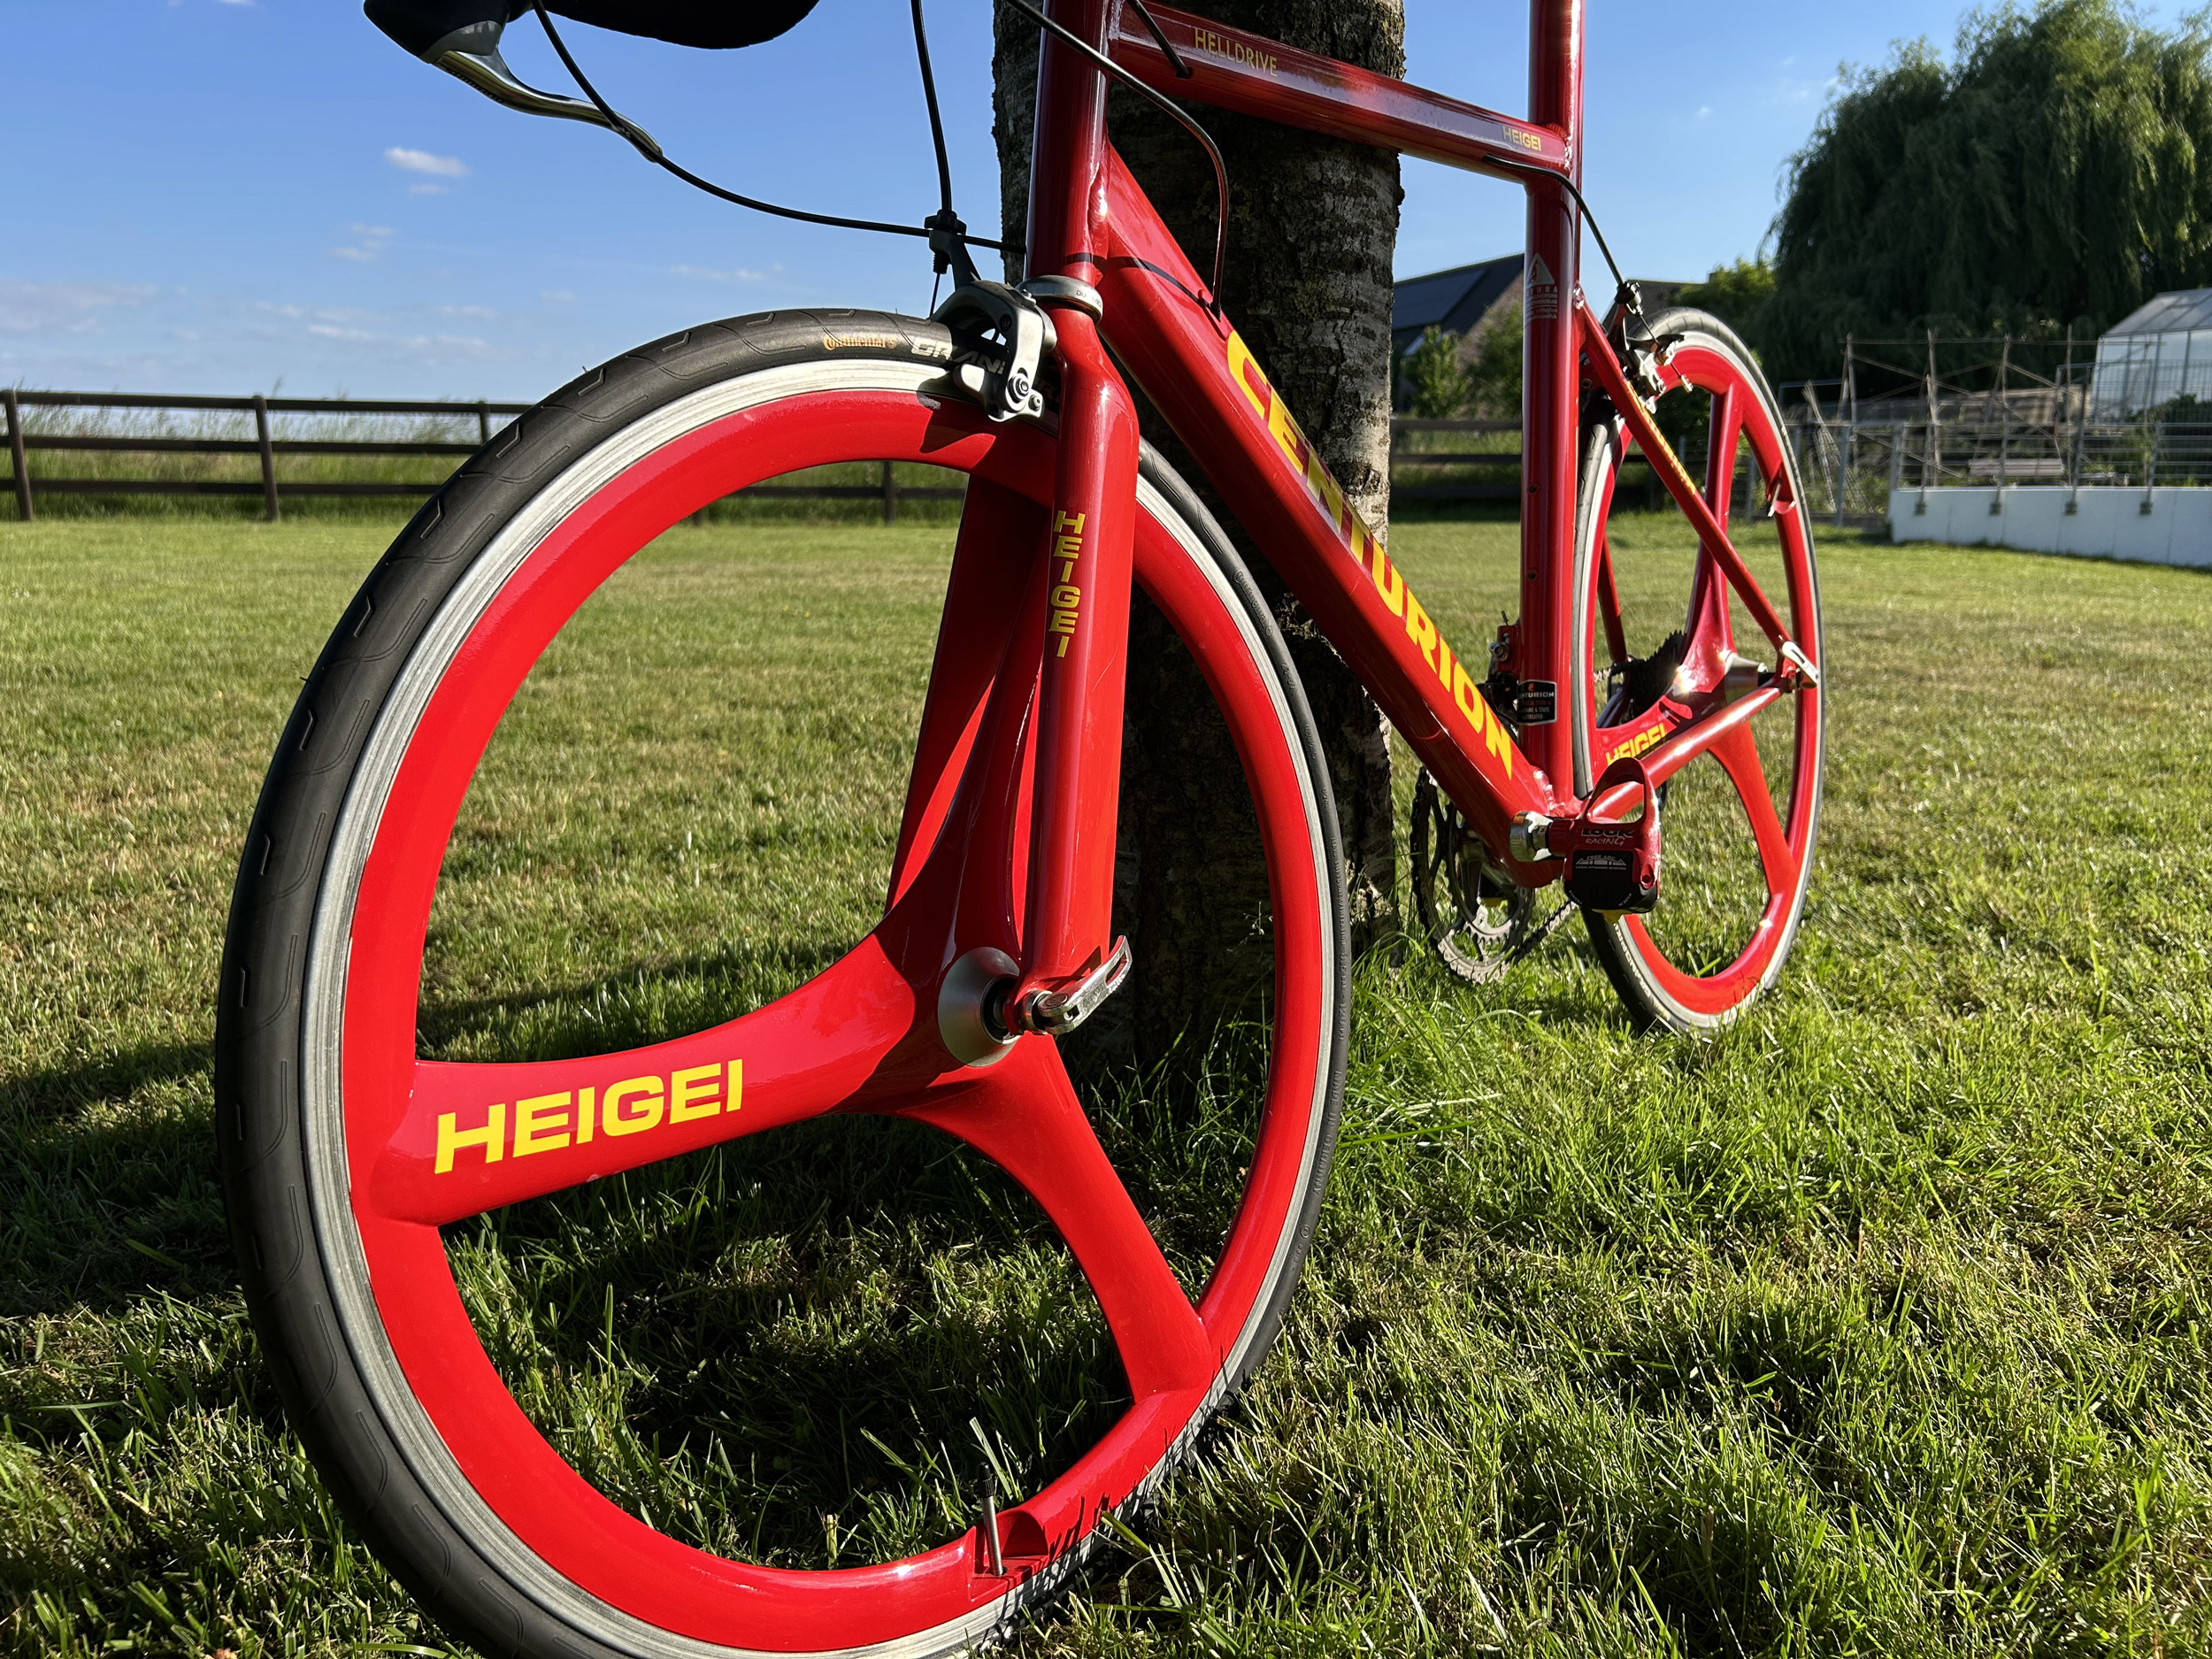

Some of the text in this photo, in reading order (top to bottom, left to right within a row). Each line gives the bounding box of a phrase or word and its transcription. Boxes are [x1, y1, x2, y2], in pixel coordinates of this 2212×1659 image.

[1194, 27, 1278, 77] HELLDRIVE
[1502, 126, 1542, 151] HEIGEI
[1226, 330, 1512, 780] CENTURION
[1048, 510, 1087, 658] HEIGEI
[1581, 827, 1635, 839] LOOK
[1585, 837, 1625, 847] RACING
[434, 1058, 743, 1175] HEIGEI
[1312, 1134, 1333, 1196] GERMANY
